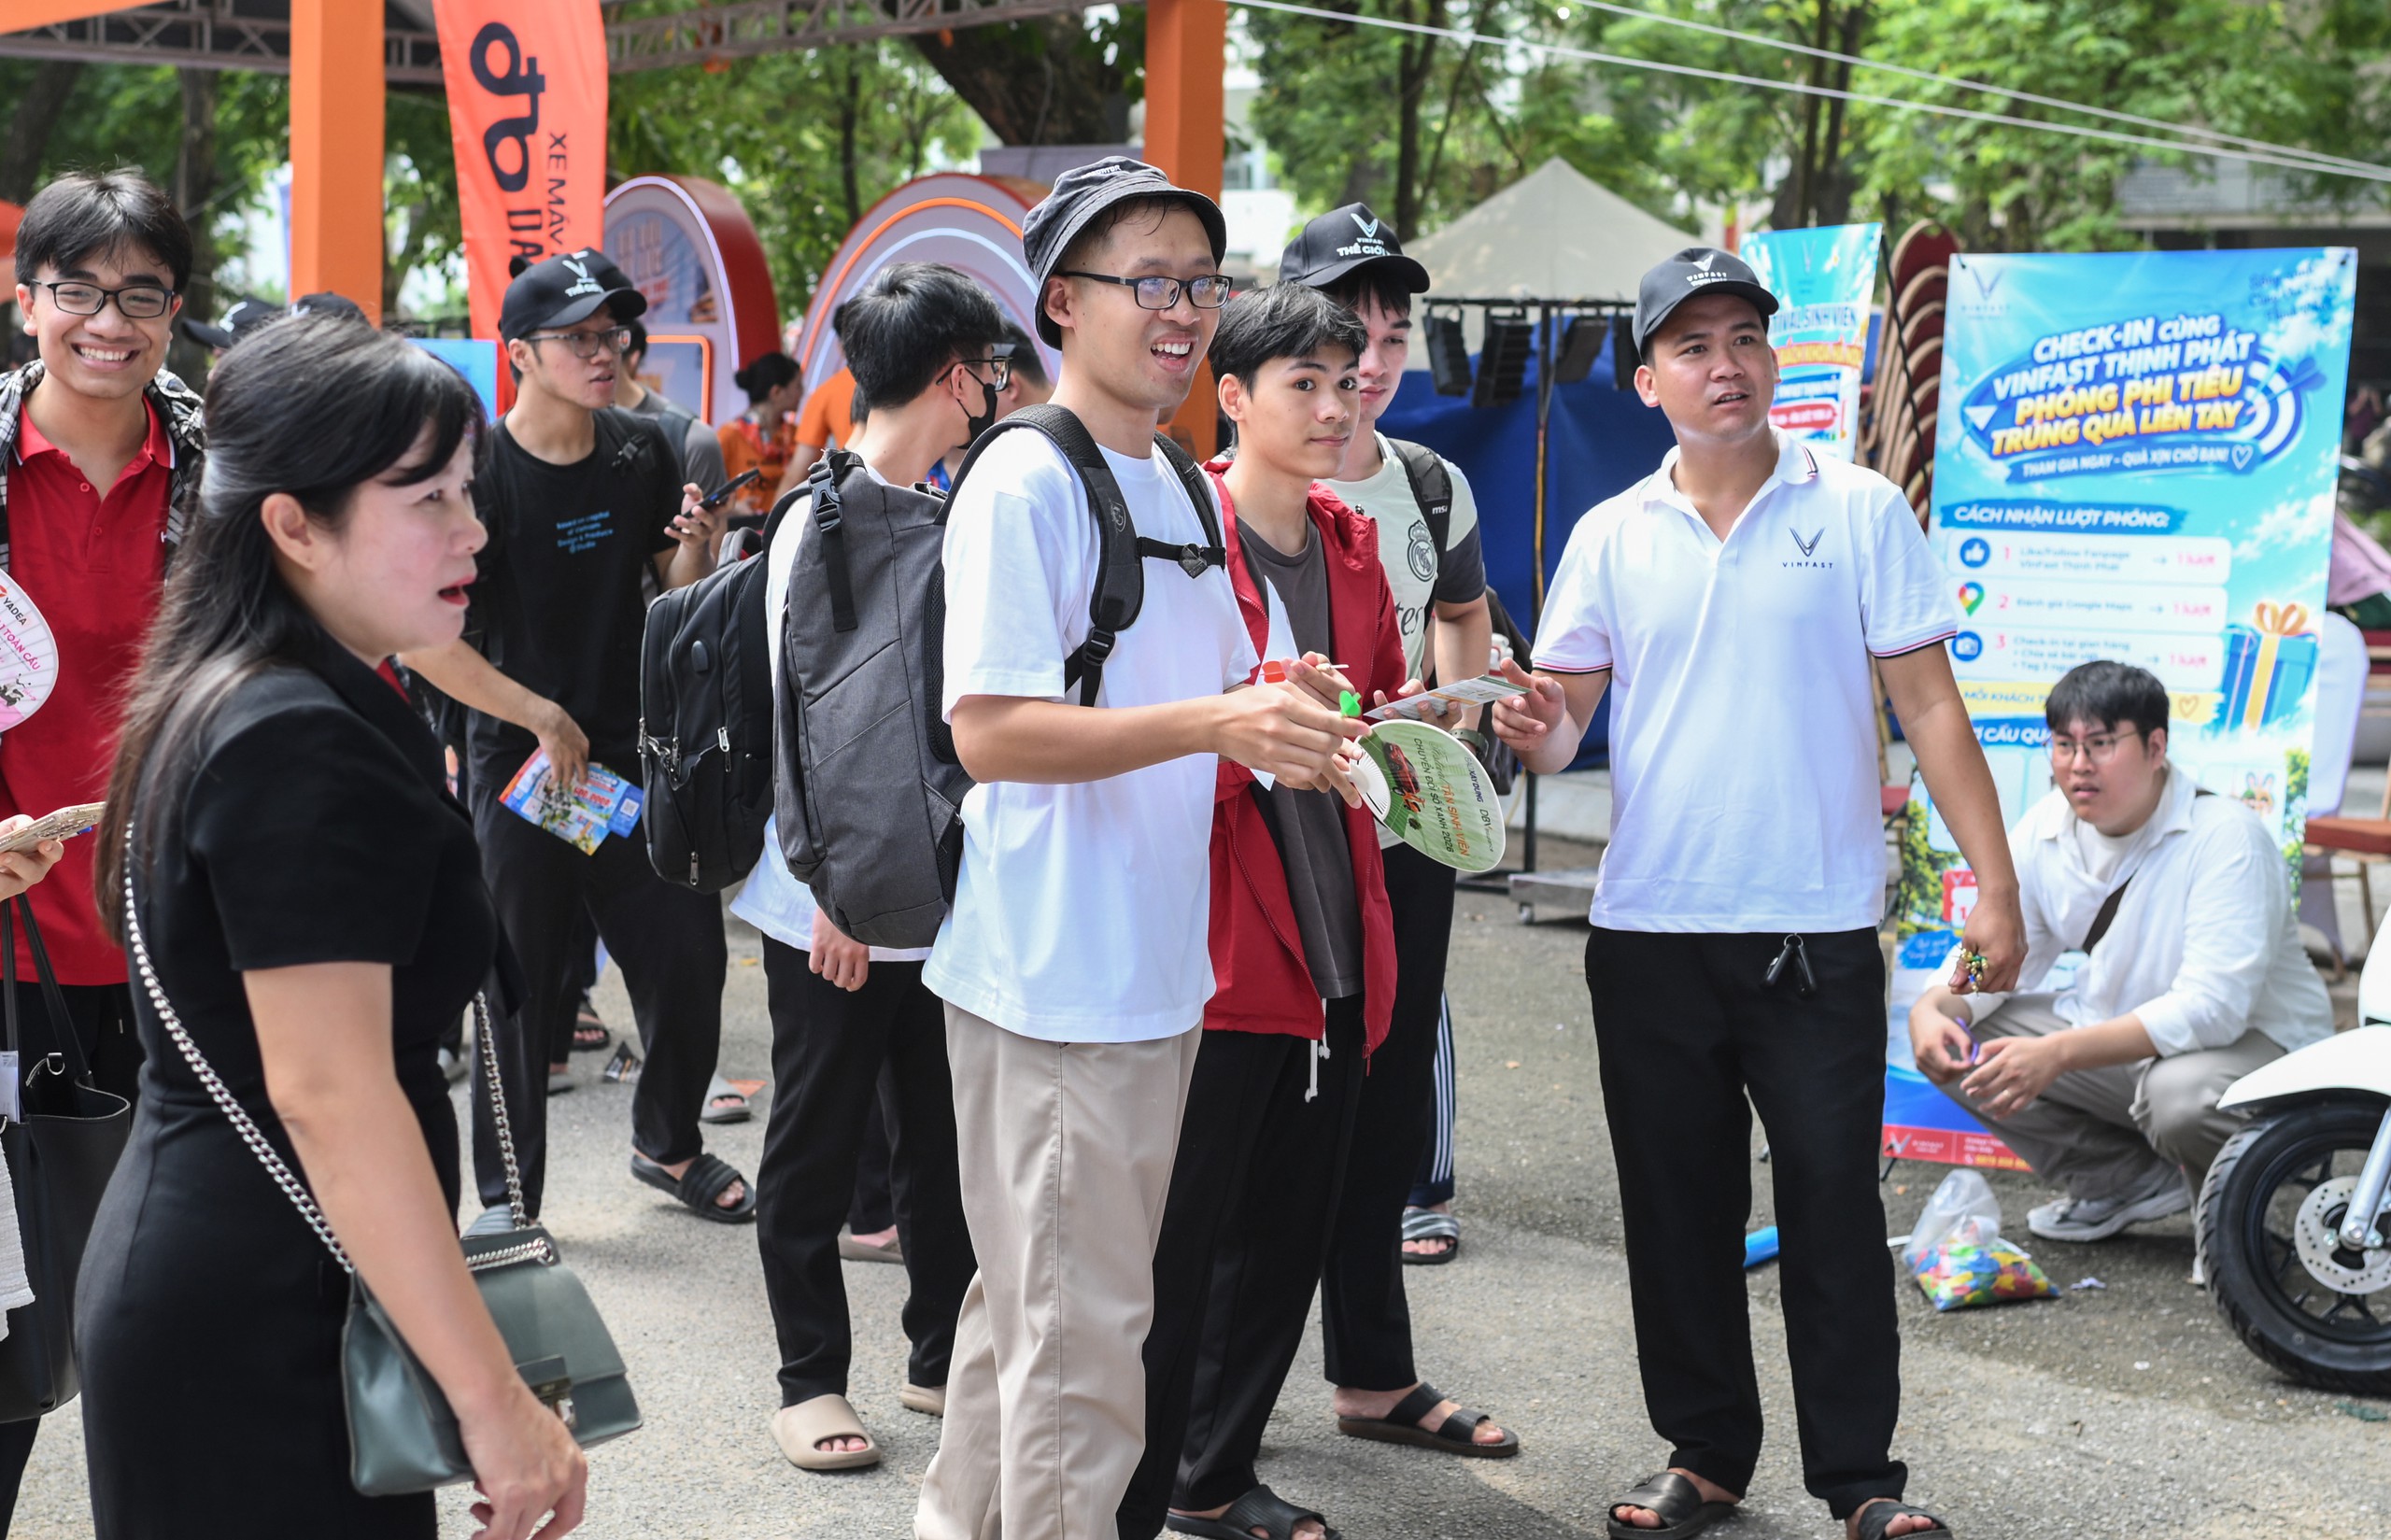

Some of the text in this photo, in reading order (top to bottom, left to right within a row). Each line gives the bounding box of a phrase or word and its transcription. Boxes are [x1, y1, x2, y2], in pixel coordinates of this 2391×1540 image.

[549, 133, 568, 171] XE
[507, 209, 545, 261] DA
[1686, 272, 1727, 282] VINFAST
[2033, 313, 2221, 363] CHECK-IN CÙNG
[1993, 329, 2257, 401] VINFAST THỊNH PHÁT
[2016, 363, 2244, 426] PHÓNG PHI TIÊU
[2139, 400, 2193, 434] LIÊN
[2195, 400, 2244, 430] TAY
[1432, 505, 1449, 515] msi
[1954, 503, 2003, 523] CÁCH
[2004, 505, 2056, 528] NHẬN
[2056, 507, 2102, 530] LƯỢT
[2004, 545, 2011, 560] 1
[3, 597, 28, 626] YADEA
[1999, 594, 2009, 610] 2
[3, 629, 26, 653] TOÀN
[1997, 634, 2006, 650] 3
[1435, 806, 1447, 830] XANH
[1441, 831, 1455, 854] 2026
[1448, 806, 1461, 831] SINH
[1456, 833, 1470, 856] VIÊN
